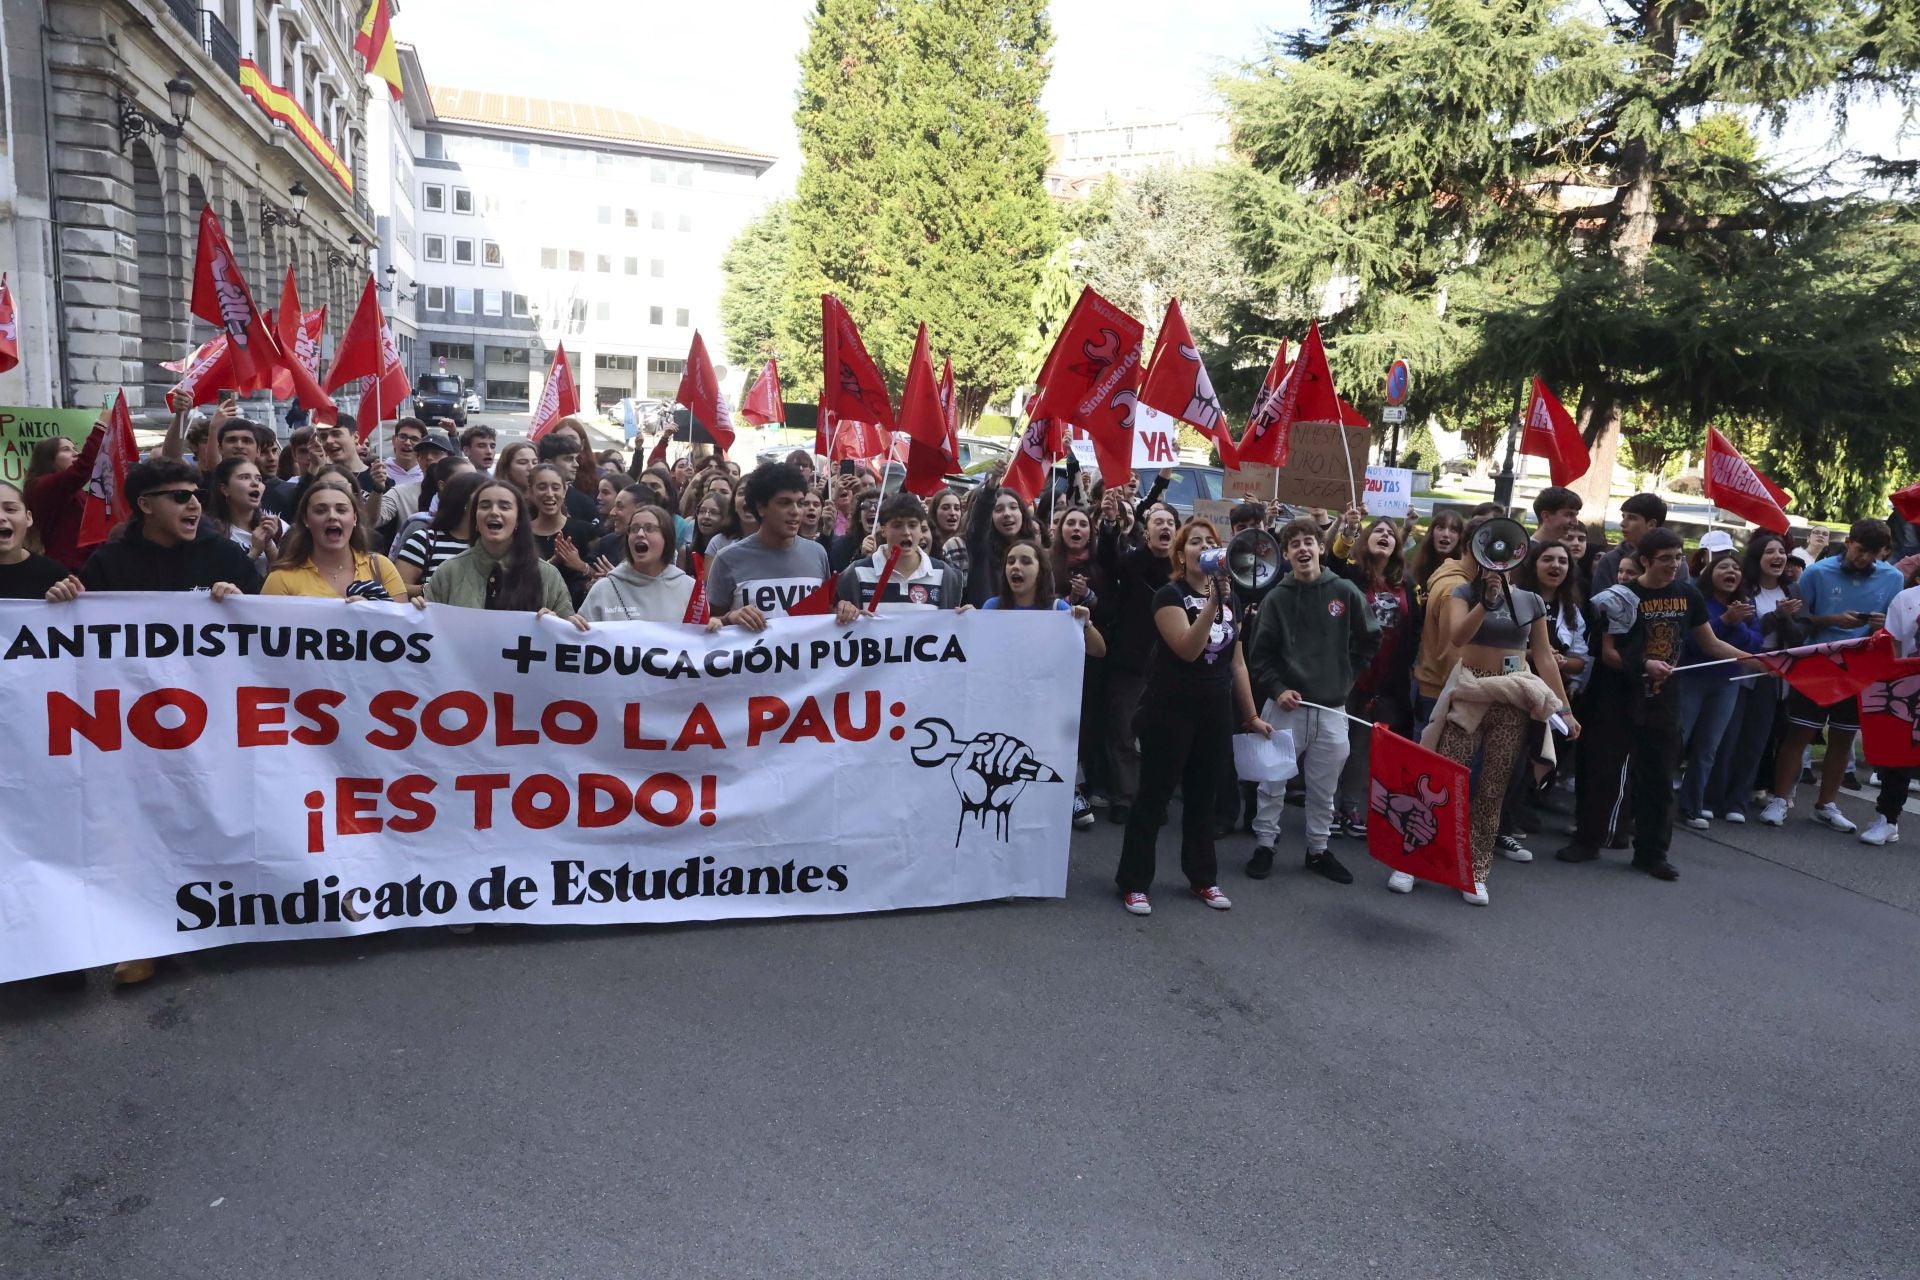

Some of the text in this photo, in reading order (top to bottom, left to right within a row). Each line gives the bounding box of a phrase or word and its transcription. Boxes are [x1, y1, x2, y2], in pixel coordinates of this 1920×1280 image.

[1080, 365, 1127, 417] Sindicato
[1124, 347, 1139, 369] de
[0, 413, 60, 437] PÁNICO
[1138, 431, 1174, 462] YA
[1291, 478, 1346, 499] JUEGA
[1364, 479, 1399, 493] PAUTAS
[4, 624, 433, 663] ANTIDISTURBIOS
[555, 632, 800, 680] EDUCACIÓN
[811, 630, 967, 670] PÚBLICA
[48, 686, 907, 756] NO ES SOLO LA PAU:
[304, 772, 717, 853] ¡ES TODO!
[176, 857, 849, 932] Sindicato de Estudiantes
